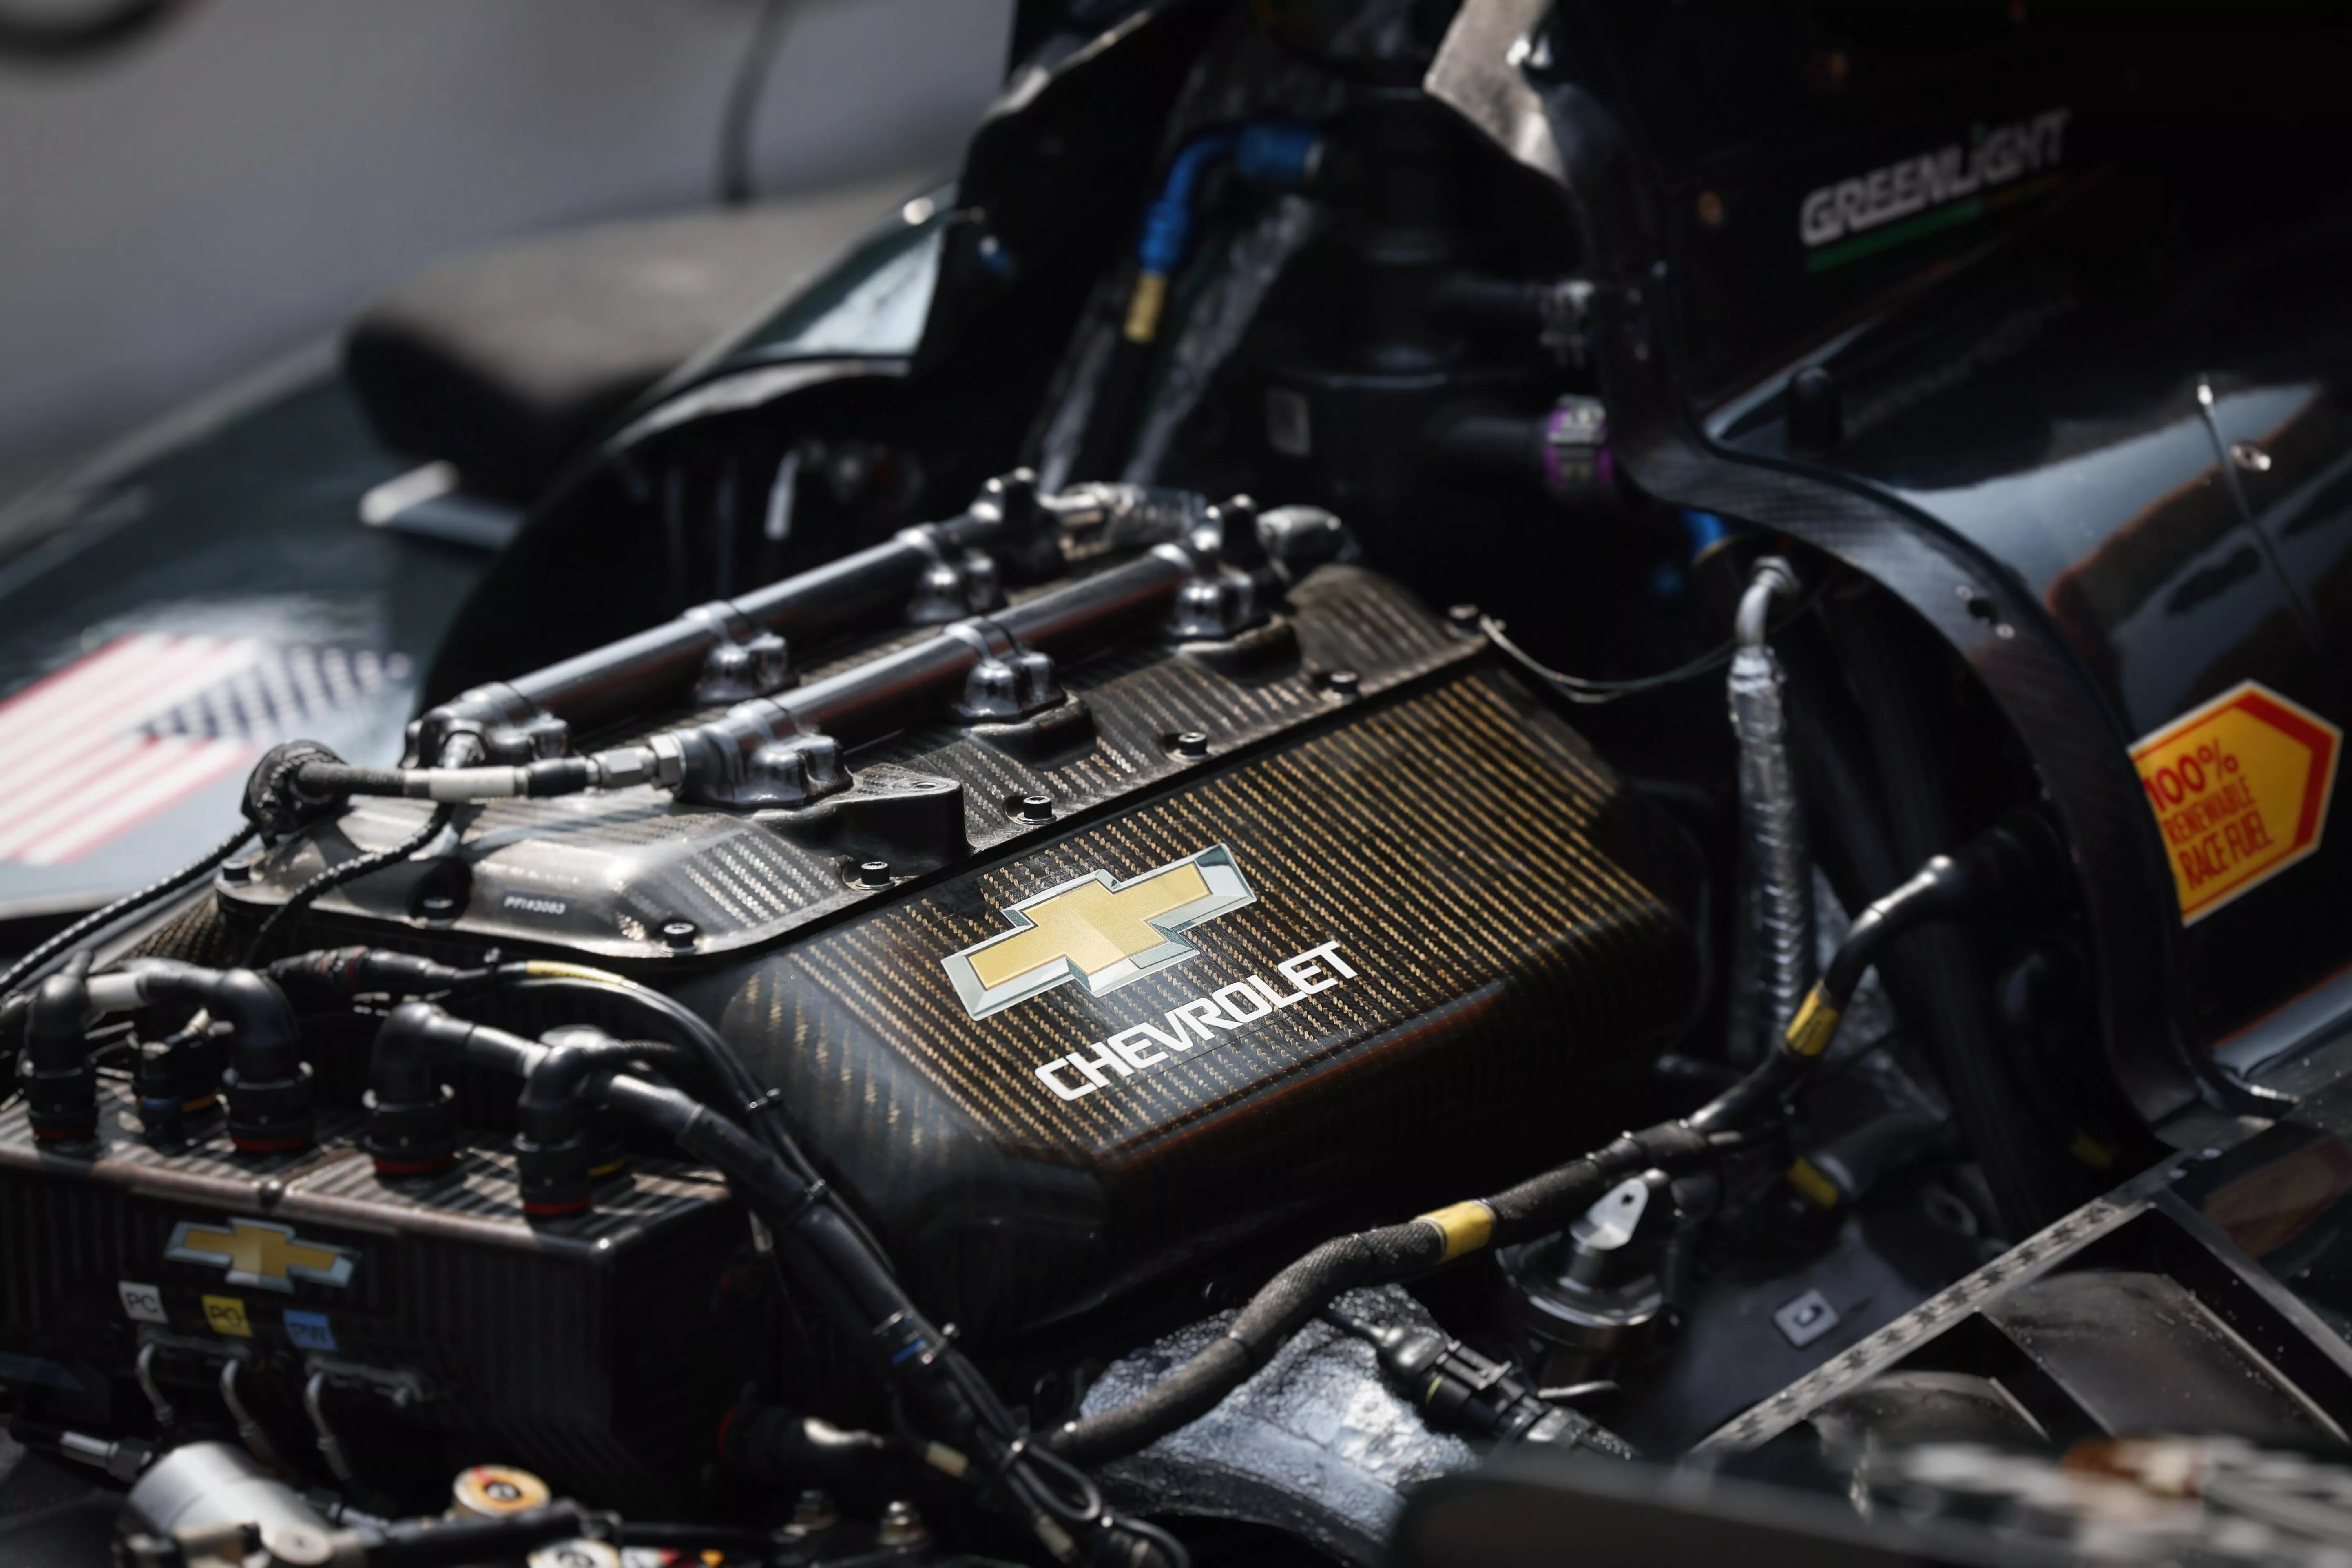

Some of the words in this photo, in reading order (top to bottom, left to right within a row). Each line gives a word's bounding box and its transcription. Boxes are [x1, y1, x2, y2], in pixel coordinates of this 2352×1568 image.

[2142, 739, 2239, 811] 100%
[2180, 832, 2229, 889] RACE
[2225, 810, 2274, 863] FUEL
[1035, 940, 1358, 1101] CHEVROLET
[126, 1292, 158, 1313] PC
